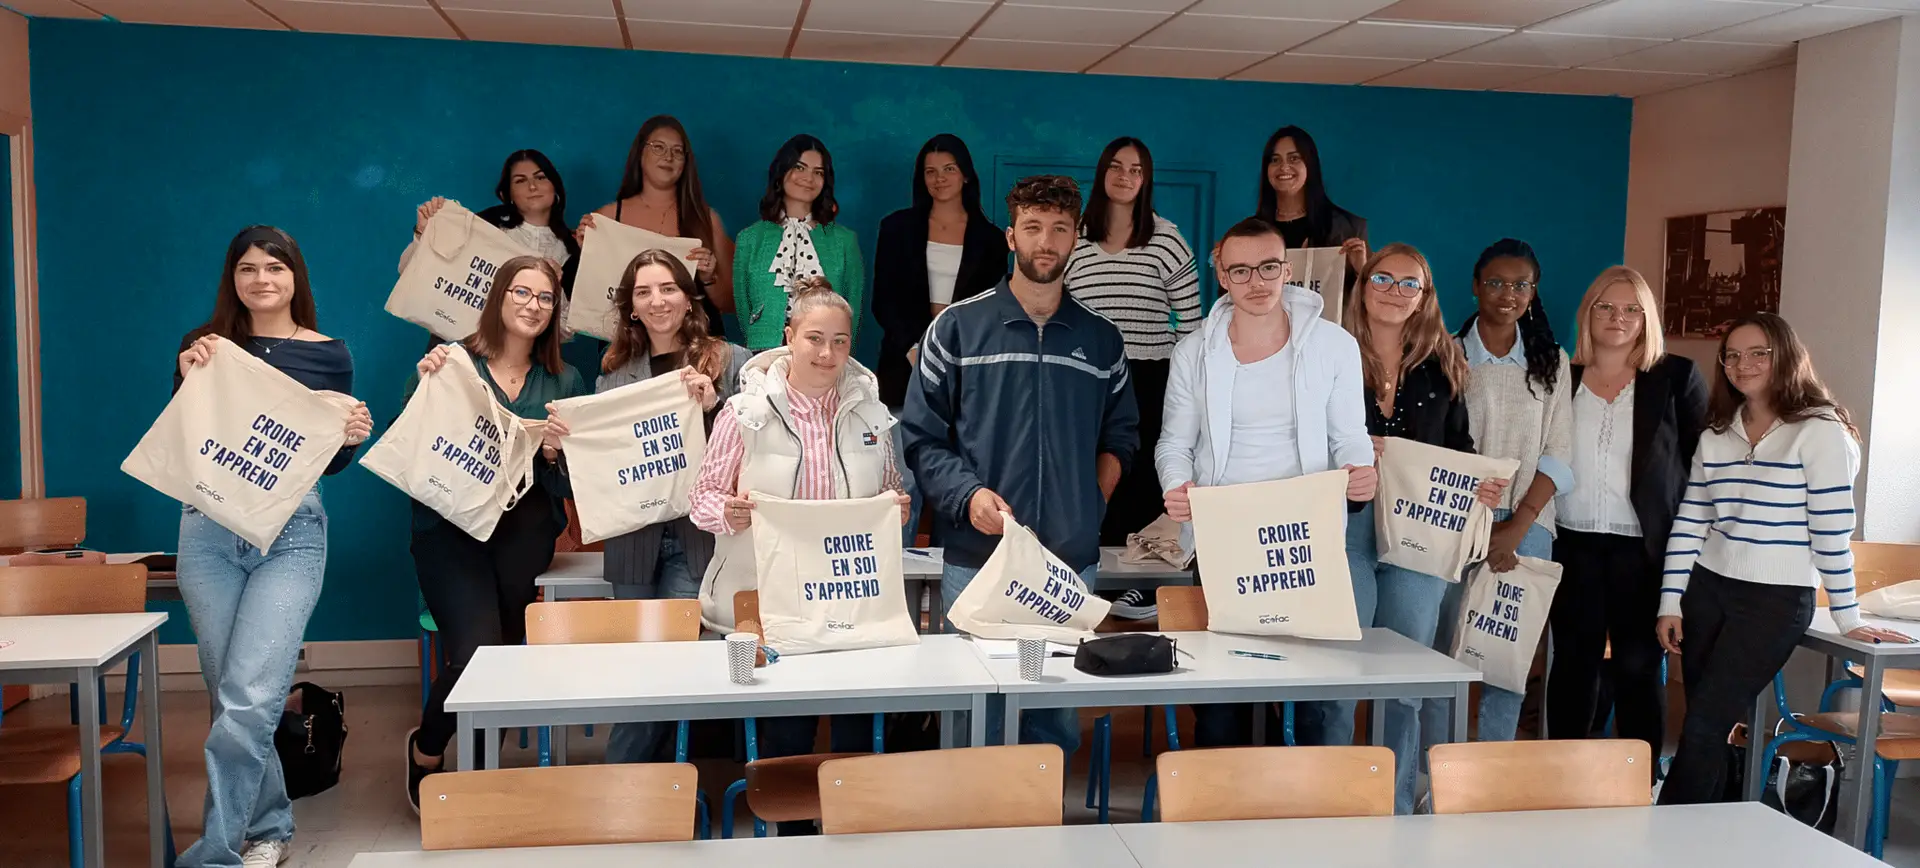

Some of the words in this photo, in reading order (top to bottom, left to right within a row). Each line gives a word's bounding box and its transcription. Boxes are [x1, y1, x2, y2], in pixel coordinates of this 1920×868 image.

[470, 256, 500, 278] CROI
[434, 276, 486, 311] S'APPREN
[465, 273, 482, 289] EN
[252, 414, 306, 452] CROIRE
[633, 412, 679, 438] CROIRE
[242, 435, 262, 458] EN
[264, 448, 292, 472] SOI
[468, 434, 486, 454] EN
[642, 439, 660, 457] EN
[662, 433, 684, 456] SOI
[200, 438, 278, 491] S'APPREND
[432, 436, 495, 485] S'APPREND
[618, 453, 687, 485] S'APPREND
[1428, 487, 1447, 505] EN
[1449, 493, 1474, 513] SOI
[1394, 498, 1467, 532] S'APPREND
[824, 533, 874, 554] CROIRE
[1258, 521, 1310, 545] CROIRE
[832, 558, 850, 576] EN
[854, 556, 877, 575] SOI
[1266, 549, 1285, 567] EN
[1290, 545, 1312, 565] SOI
[804, 579, 880, 601] S'APPREND
[1043, 576, 1062, 598] EN
[1061, 588, 1085, 612] SOI
[1237, 568, 1315, 594] S'APPREND
[1497, 580, 1525, 603] ROIRE
[1005, 580, 1072, 624] S'APPREND
[1492, 600, 1502, 616] N
[1503, 604, 1519, 622] SO
